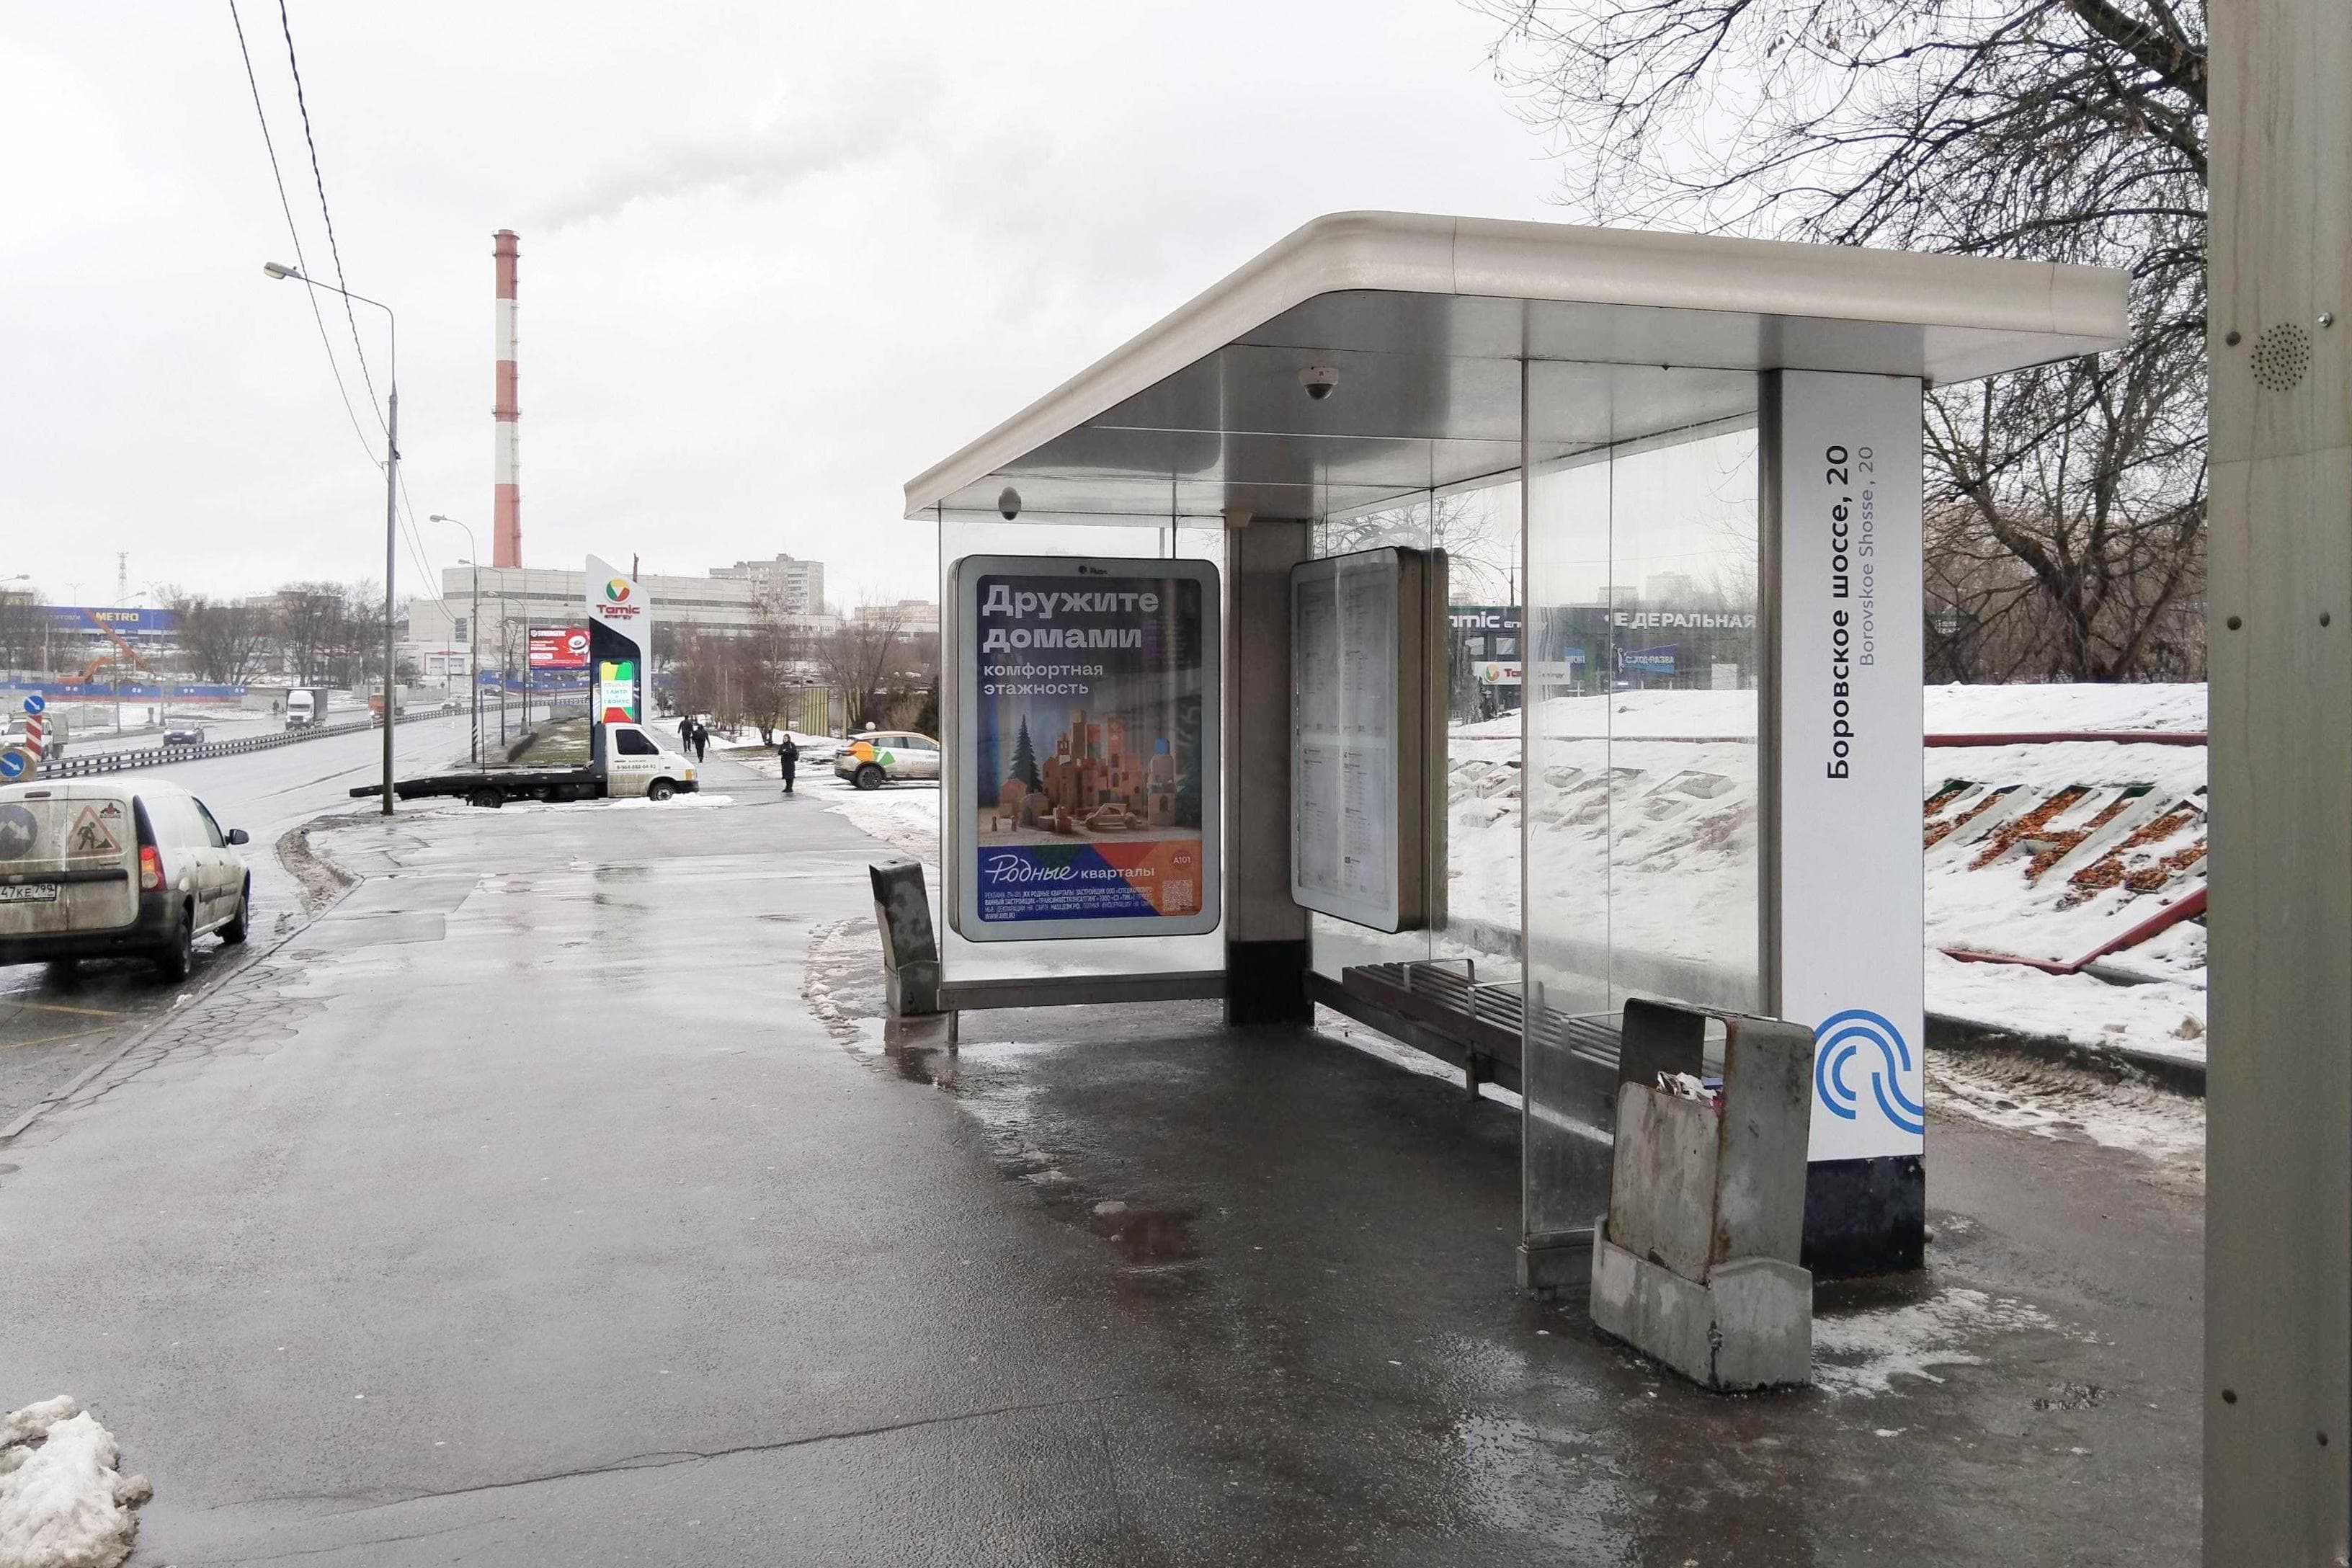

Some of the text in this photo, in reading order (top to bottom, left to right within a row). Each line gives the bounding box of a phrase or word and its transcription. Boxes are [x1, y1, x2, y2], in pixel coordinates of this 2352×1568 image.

[1858, 447, 1876, 666] Borovskoe Shosse, 20
[596, 604, 640, 614] Tamic
[982, 584, 1159, 619] Дружите
[1826, 445, 1854, 779] Боровское шоссе, 20
[95, 612, 139, 622] METRO
[1448, 611, 1500, 628] amic
[982, 628, 1142, 653] домами
[984, 662, 1104, 679] комфортная
[984, 683, 1089, 695] этажность
[984, 854, 1154, 884] Родные кварталы
